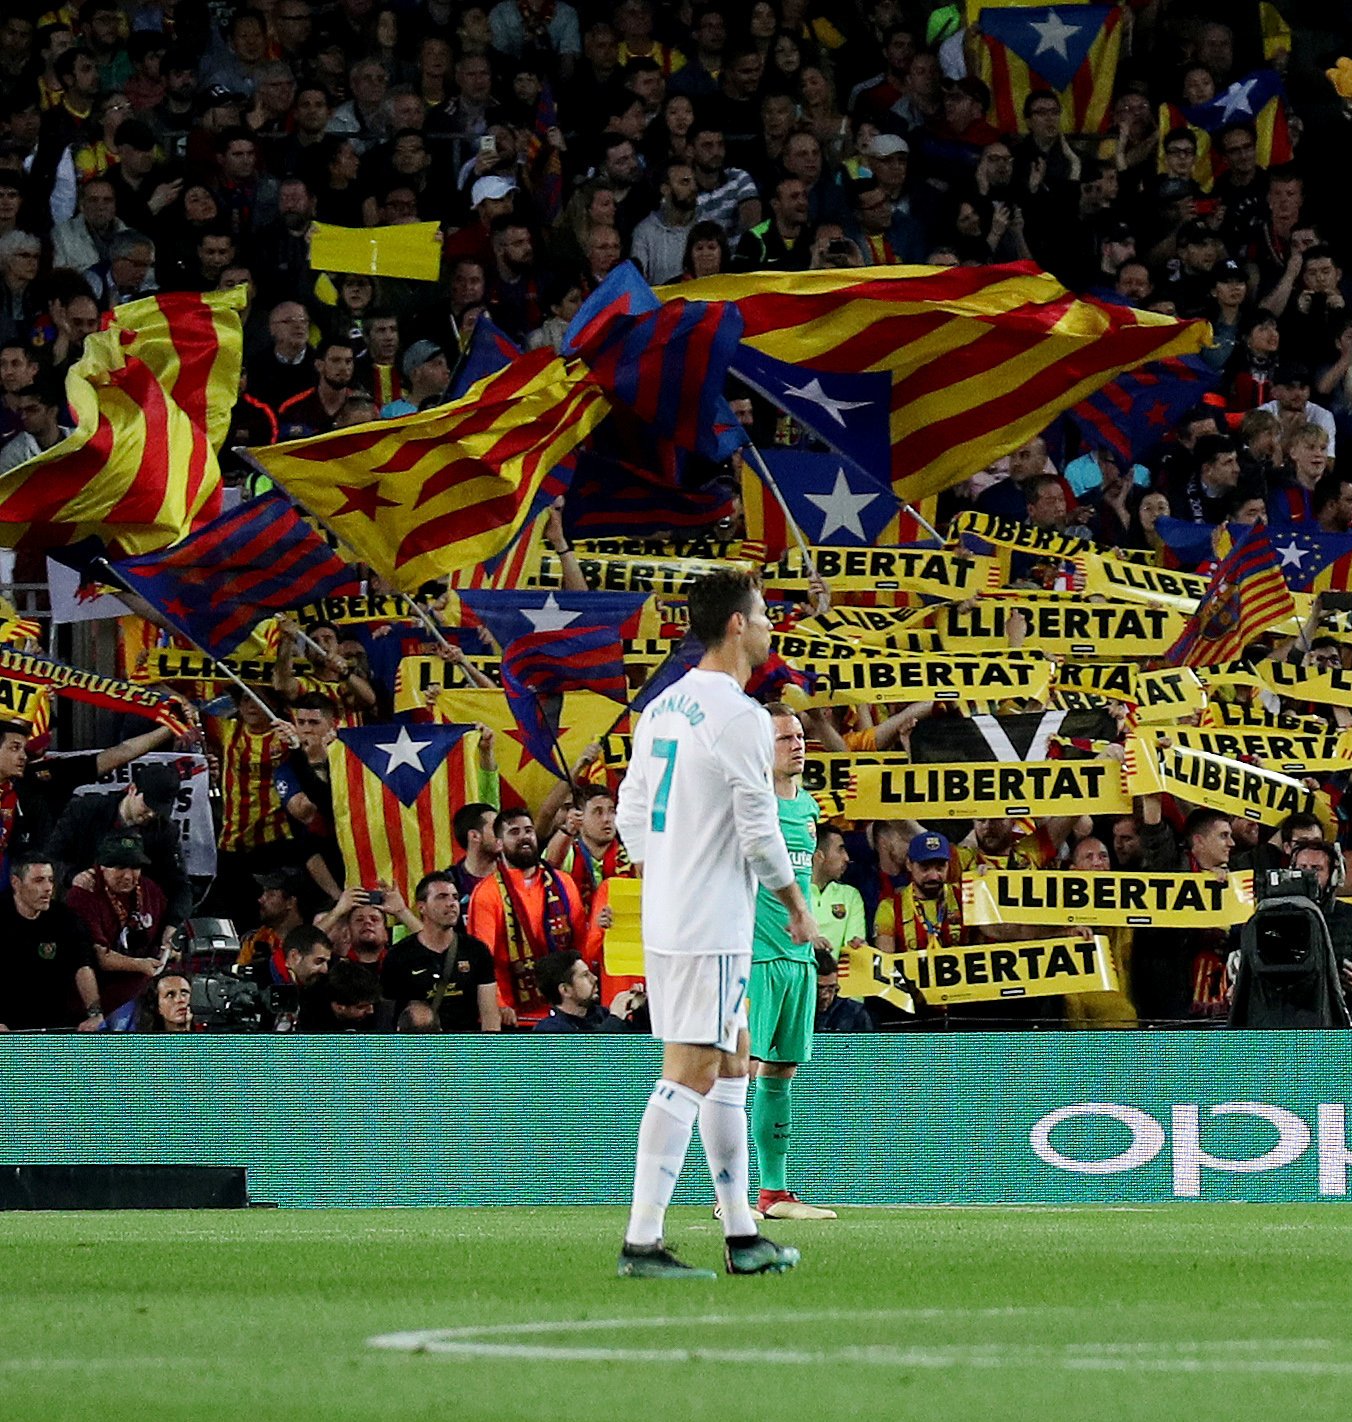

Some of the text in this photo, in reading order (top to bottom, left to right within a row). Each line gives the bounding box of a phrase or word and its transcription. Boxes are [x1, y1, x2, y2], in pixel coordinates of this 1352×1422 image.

[1103, 562, 1211, 599] LLIBE
[299, 595, 416, 625] LIBERT
[815, 606, 917, 631] LLIBE
[1220, 702, 1326, 735] LLIBE
[651, 738, 678, 832] 7
[881, 767, 1105, 803] LLIBERTAT
[998, 875, 1228, 911] LLIBERTAT
[873, 942, 1097, 990] LLIBERTAT
